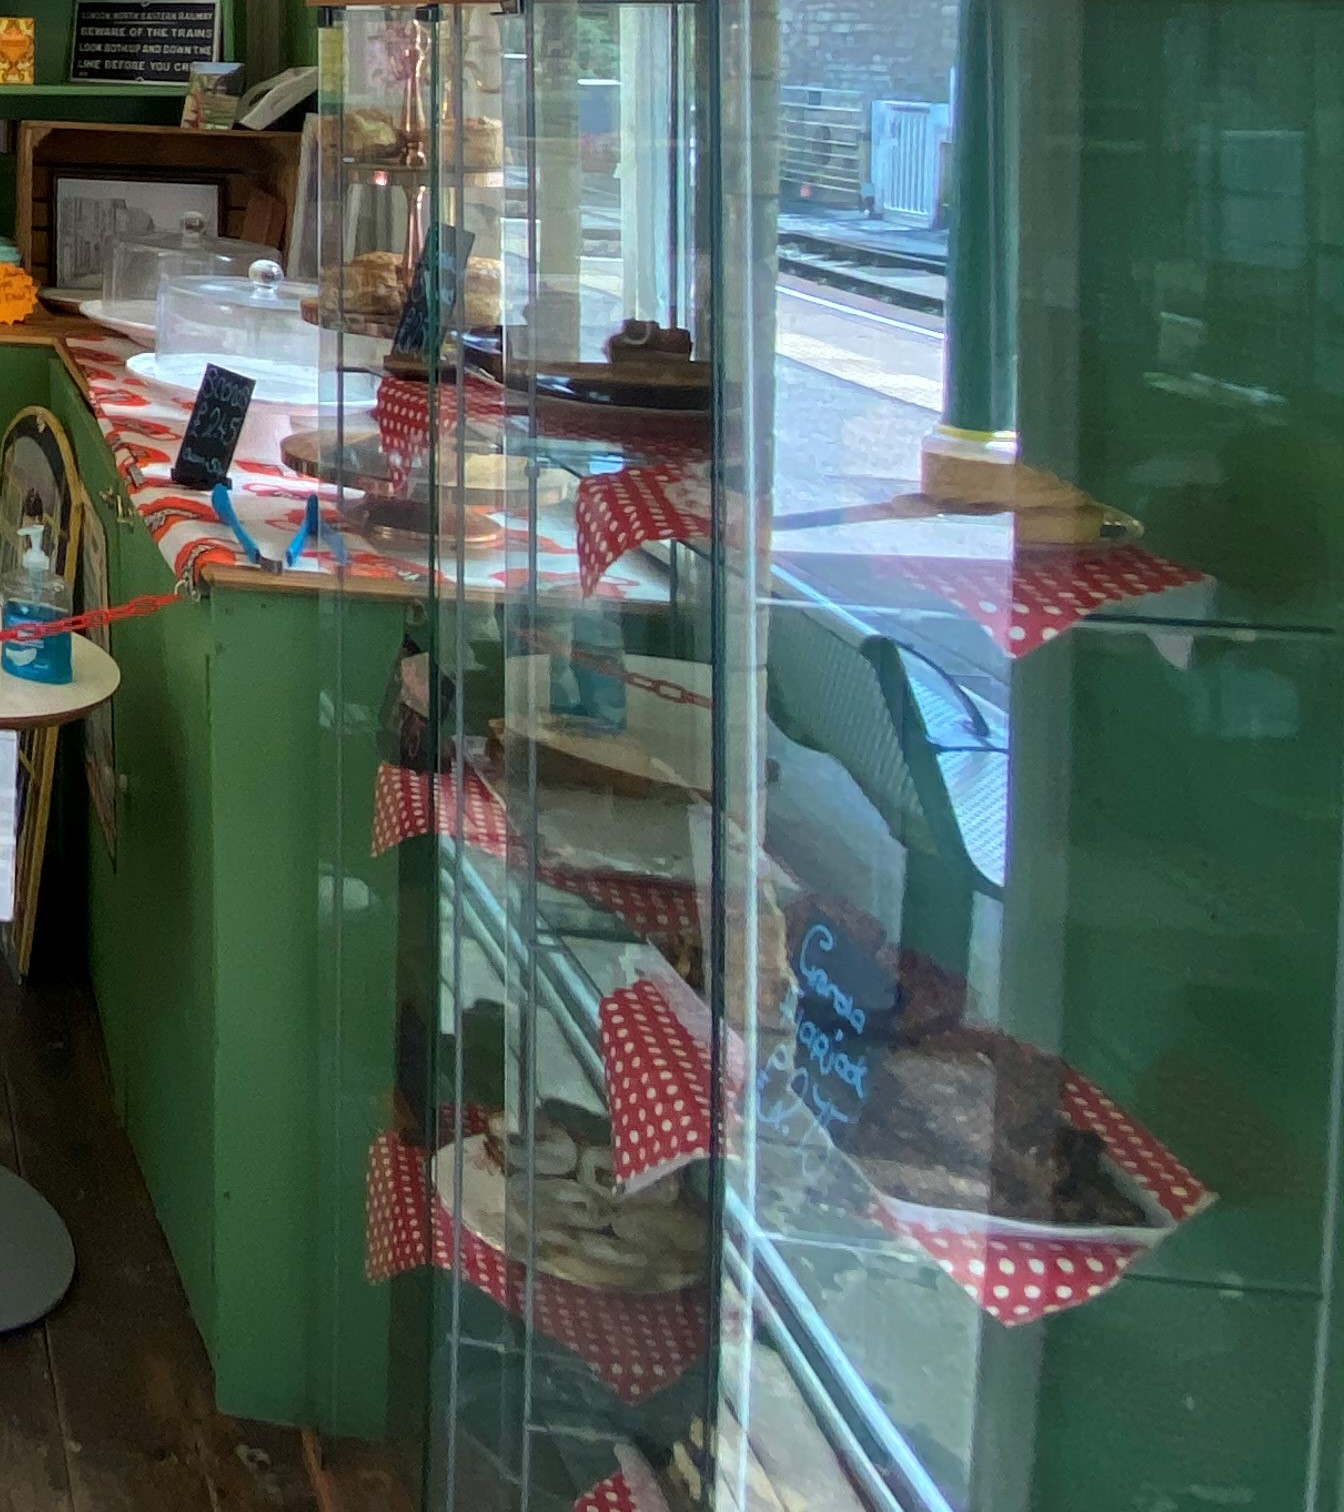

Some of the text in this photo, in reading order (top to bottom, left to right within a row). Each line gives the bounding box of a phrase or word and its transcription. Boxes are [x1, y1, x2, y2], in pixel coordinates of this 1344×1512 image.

[80, 27, 213, 38] BEWARE OF THE TRAINS
[105, 60, 146, 70] BEFORE
[150, 61, 171, 71] YOU
